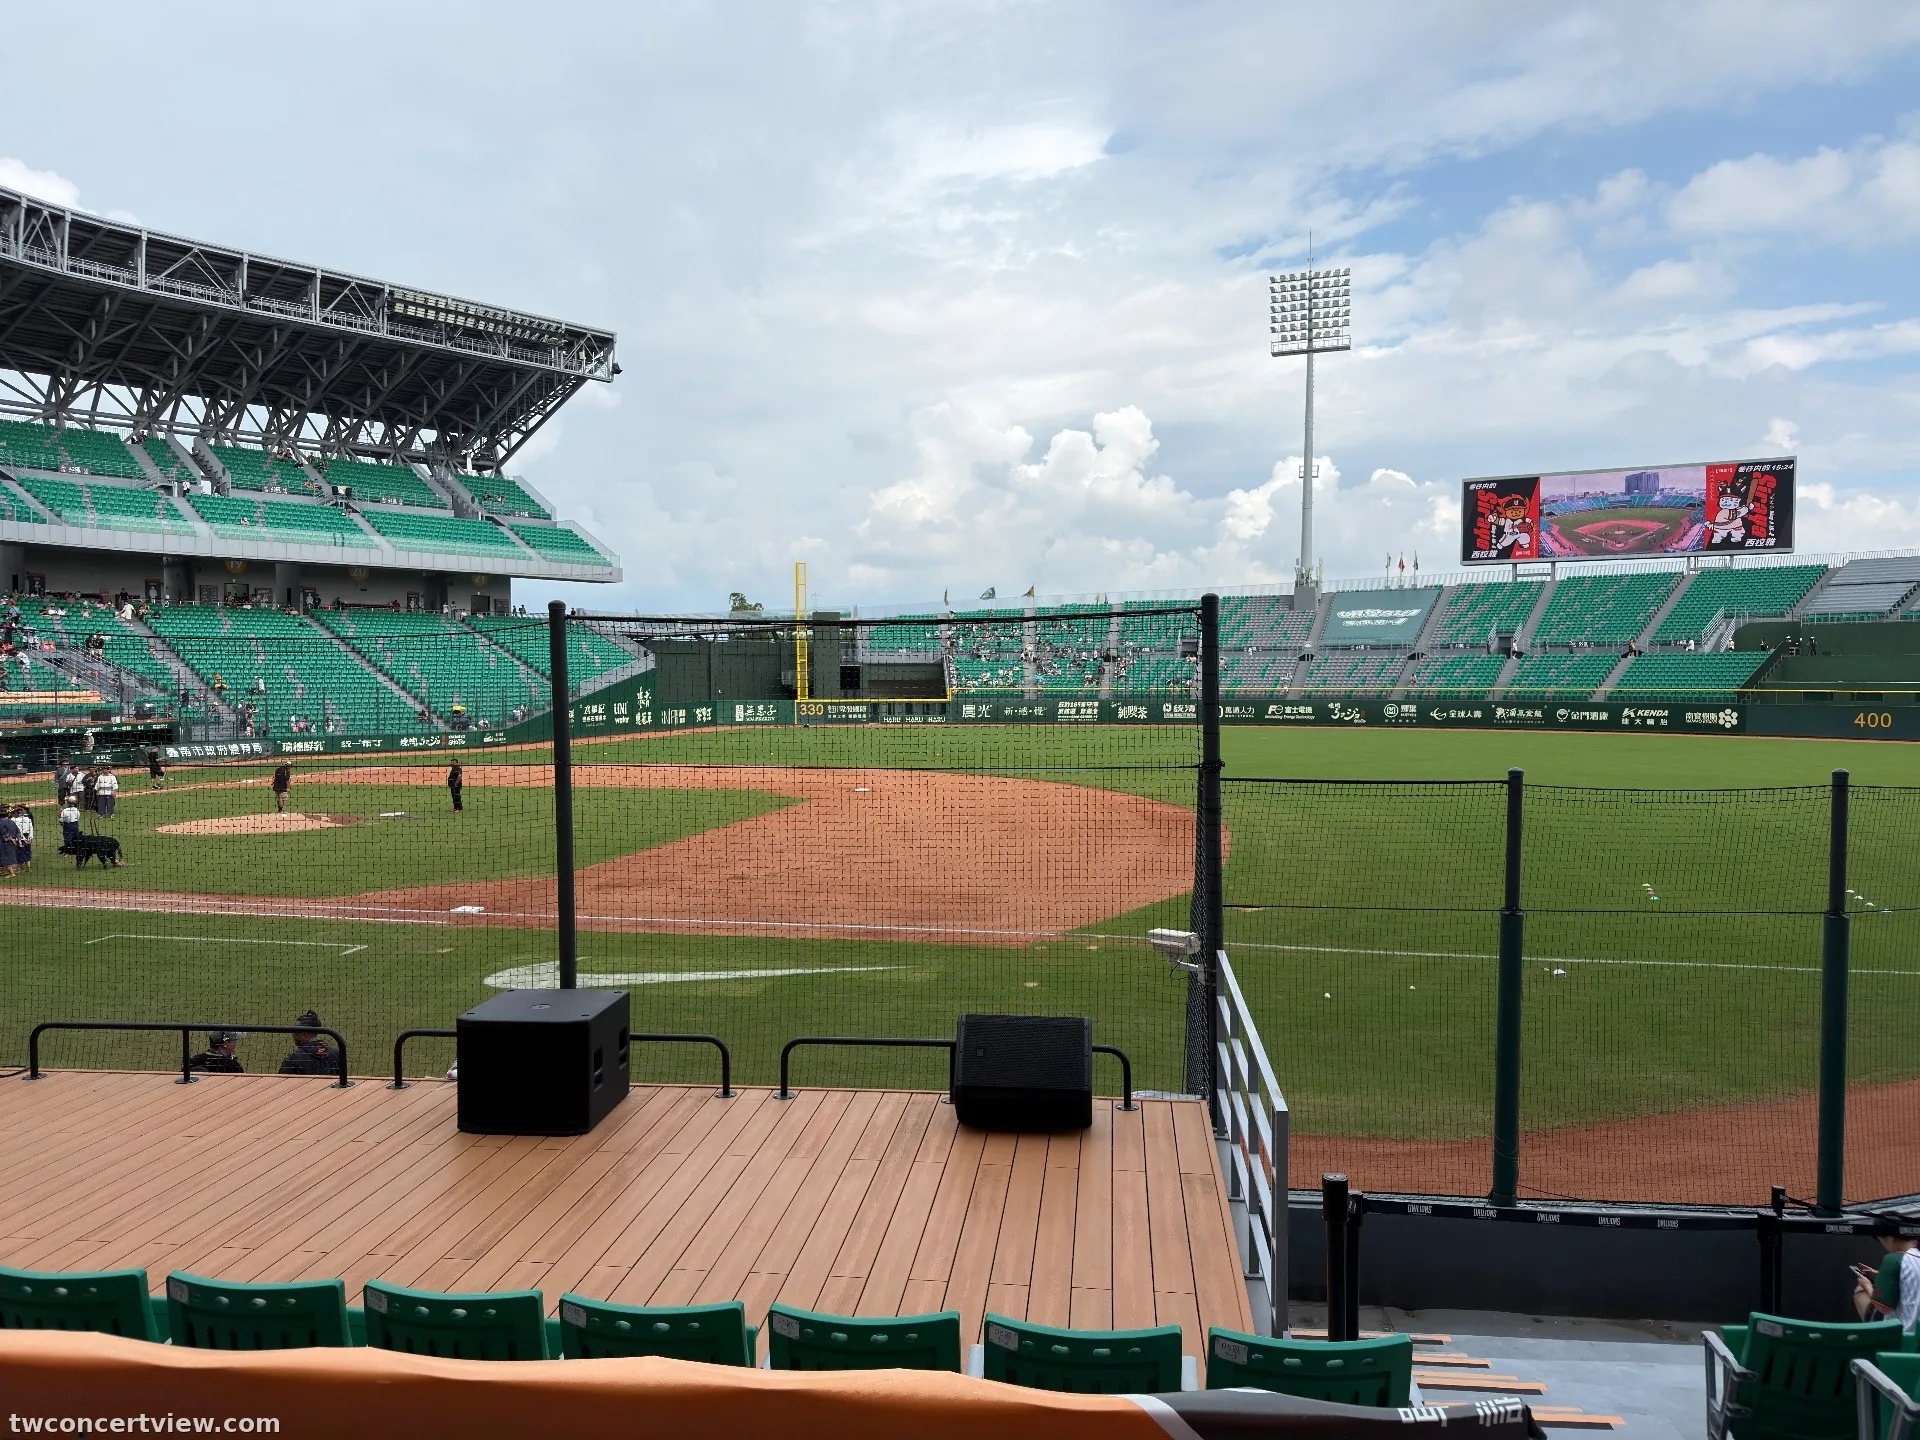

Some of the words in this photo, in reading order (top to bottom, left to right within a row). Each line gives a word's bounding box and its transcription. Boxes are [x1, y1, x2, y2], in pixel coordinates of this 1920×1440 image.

[800, 704, 824, 715] 330
[962, 705, 991, 718] 晨光
[1117, 706, 1147, 719] 純喫茶
[1285, 706, 1313, 714] 富士電機
[1449, 710, 1482, 718] 全球人壽
[1622, 718, 1667, 726] 建大輪胎
[1854, 712, 1892, 728] 400
